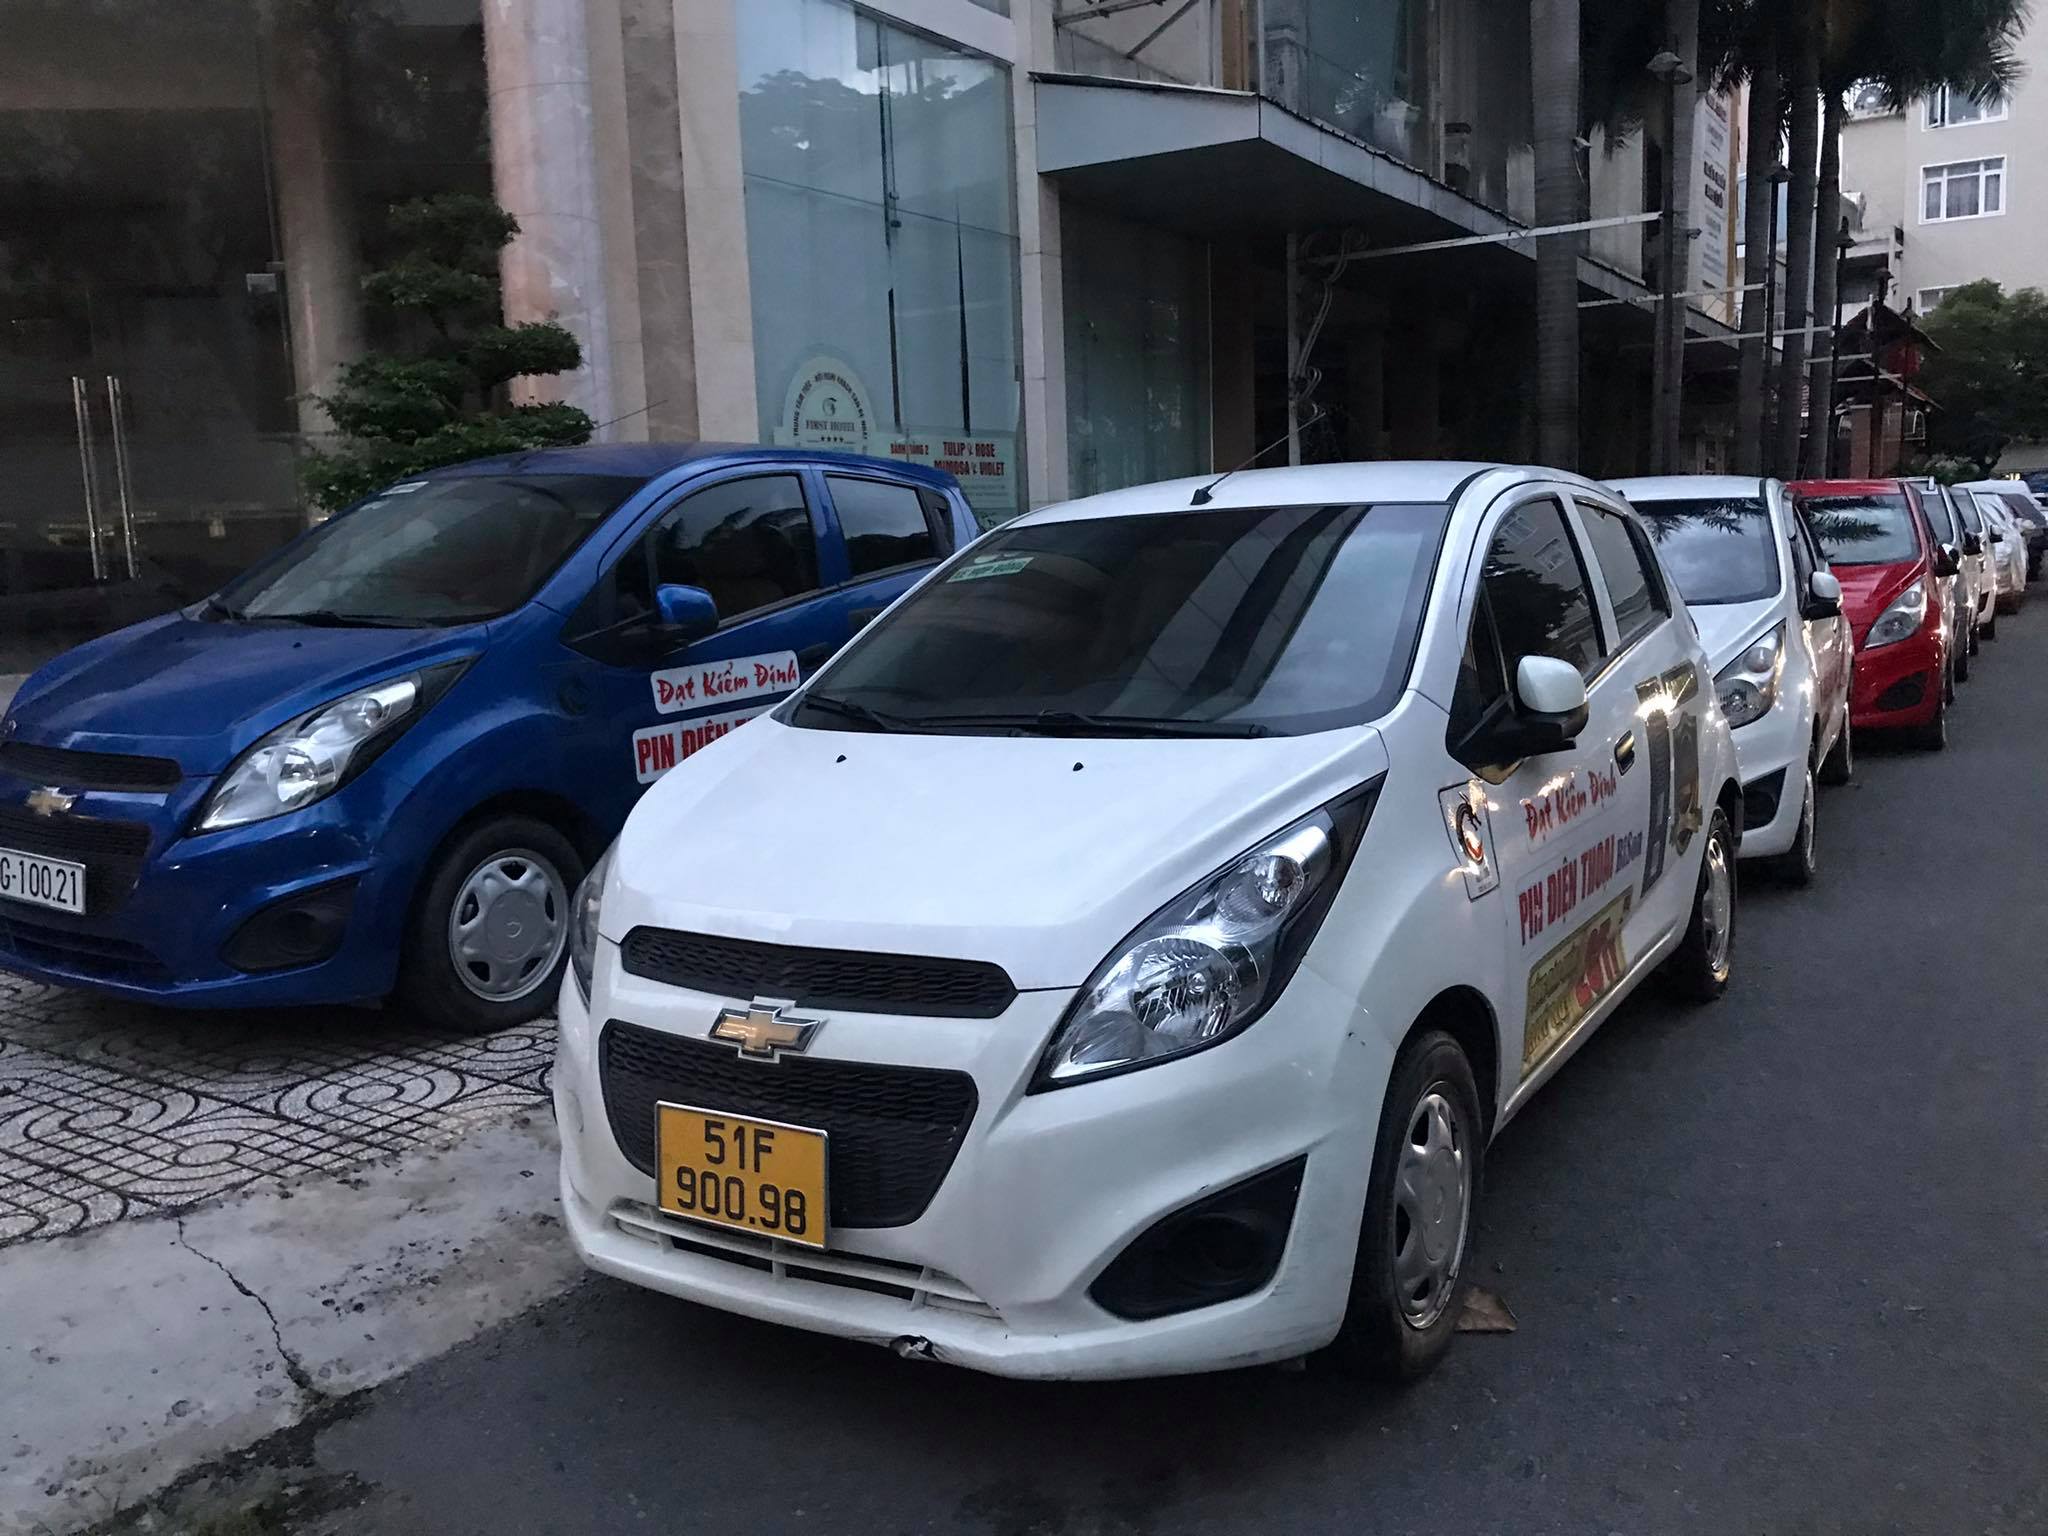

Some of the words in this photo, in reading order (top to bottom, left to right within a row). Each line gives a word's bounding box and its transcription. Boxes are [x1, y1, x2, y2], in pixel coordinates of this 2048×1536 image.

[806, 420, 827, 430] FIRST
[943, 441, 965, 457] TULIP
[975, 443, 995, 457] ROSE
[979, 461, 1005, 476] VIOLET
[656, 676, 695, 707] Đạt
[702, 661, 748, 697] Kiểm
[754, 659, 797, 691] Định
[637, 733, 676, 774] PIN
[1518, 881, 1543, 946] PIN
[704, 1119, 775, 1173] 51F
[676, 1165, 807, 1235] 900.98
